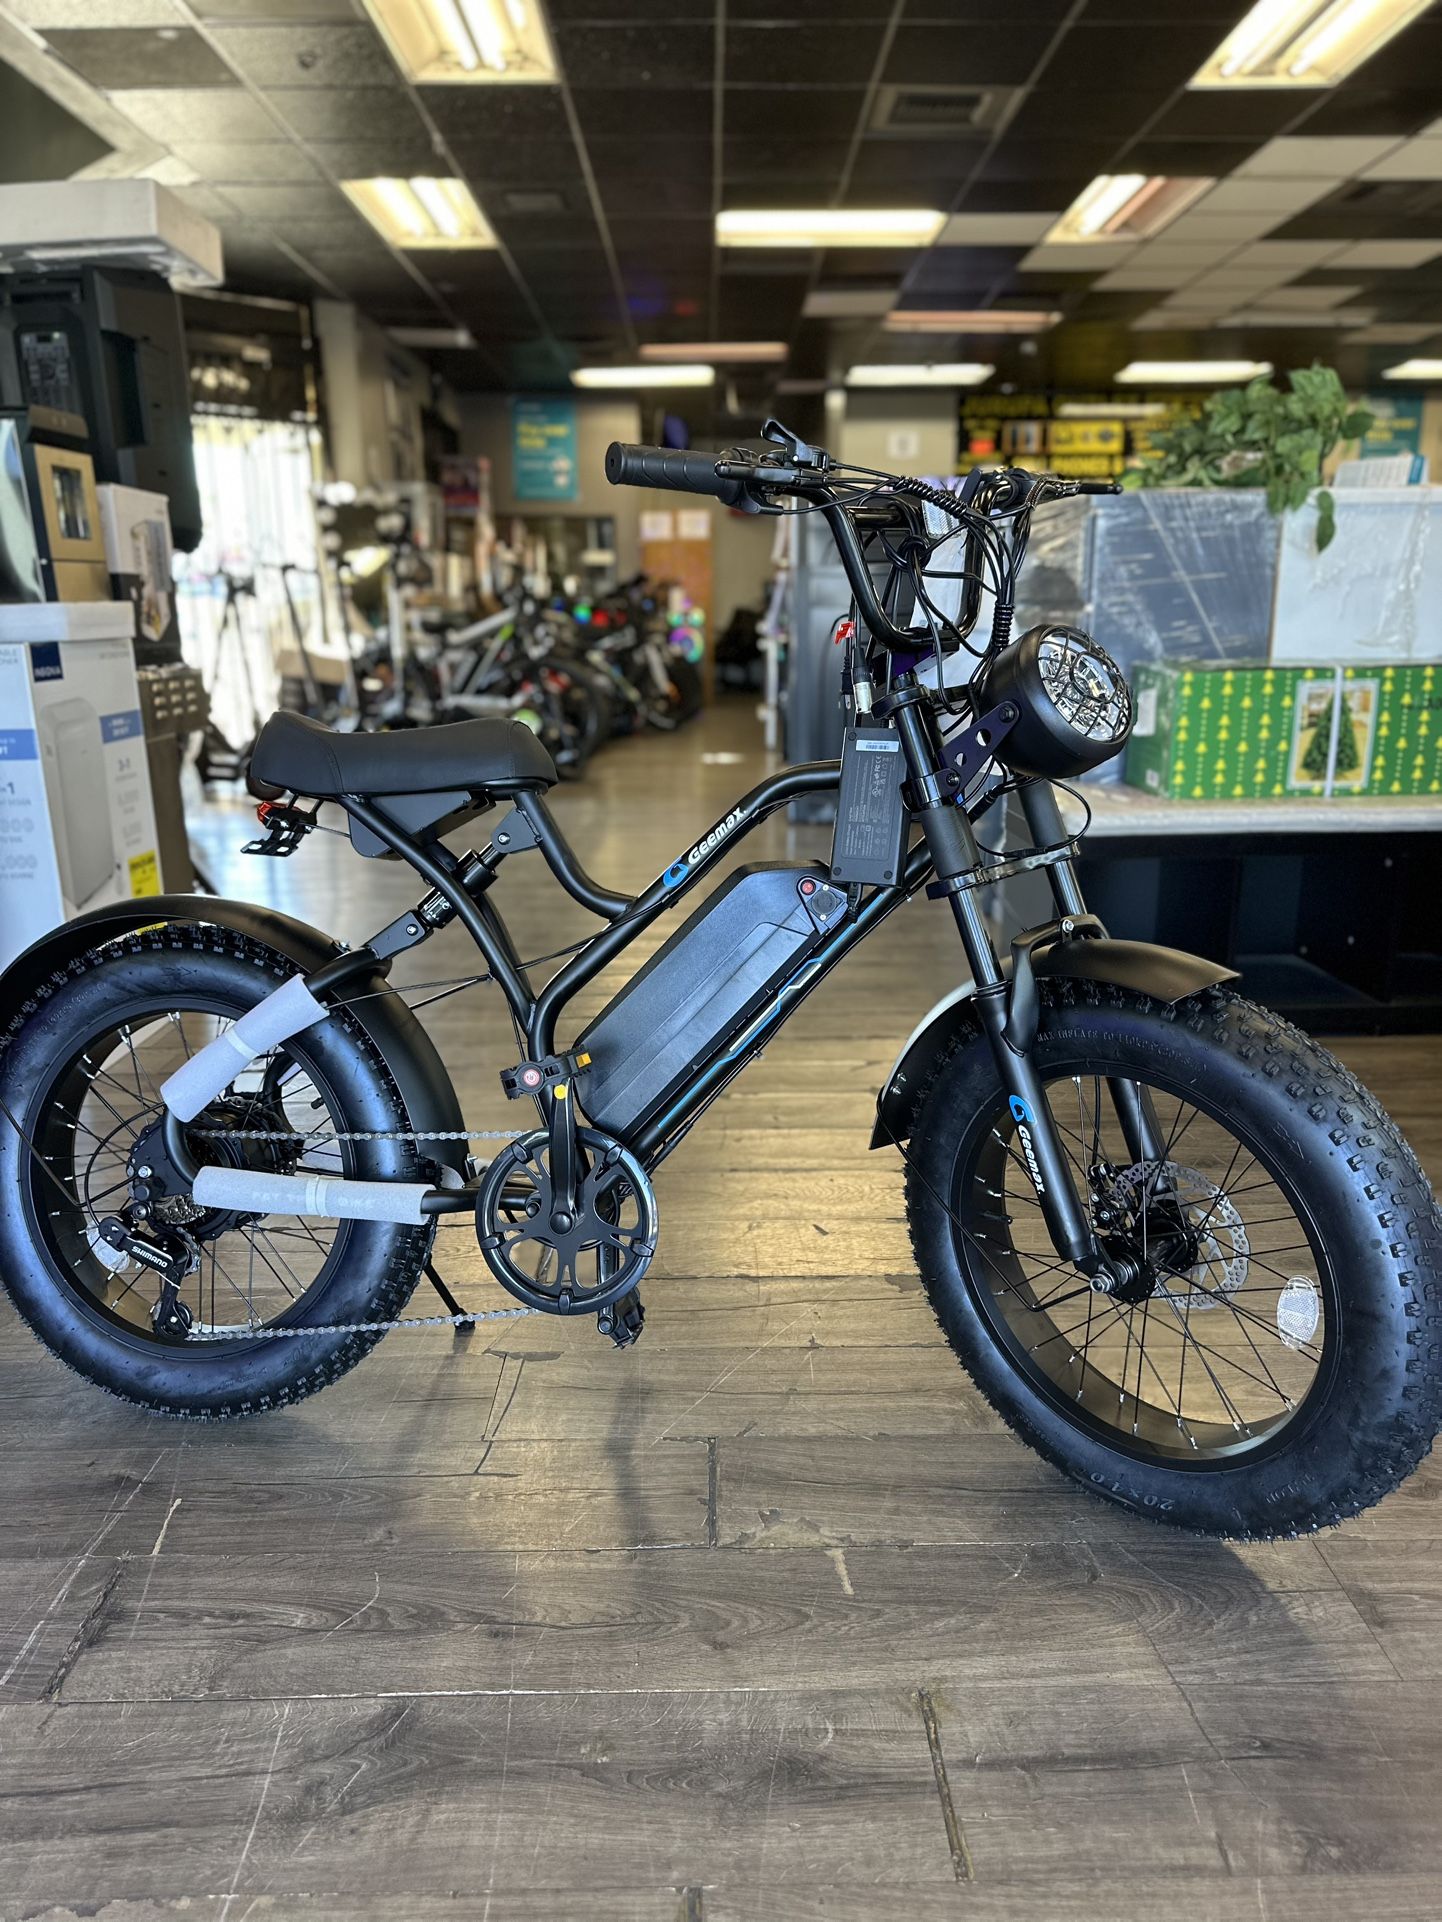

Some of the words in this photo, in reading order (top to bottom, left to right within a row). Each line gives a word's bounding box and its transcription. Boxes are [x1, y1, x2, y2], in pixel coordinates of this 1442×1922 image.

[688, 806, 745, 865] Geemax
[1018, 1124, 1045, 1194] Geemax
[132, 1245, 168, 1268] SHIMANO
